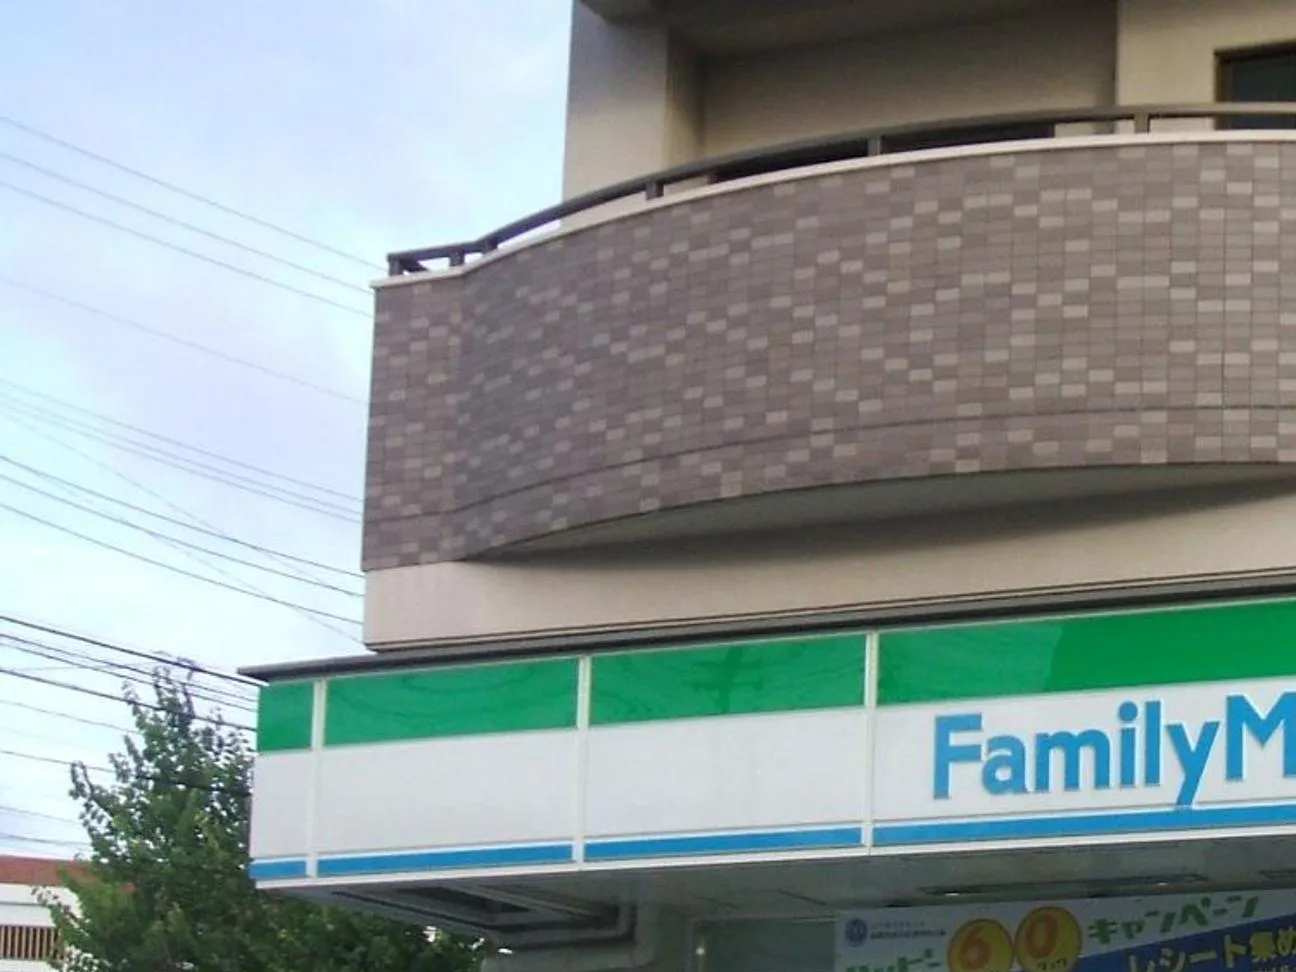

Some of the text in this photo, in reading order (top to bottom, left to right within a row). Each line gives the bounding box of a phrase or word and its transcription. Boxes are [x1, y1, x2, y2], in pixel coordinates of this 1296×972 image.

[1088, 895, 1259, 945] キャンペーン
